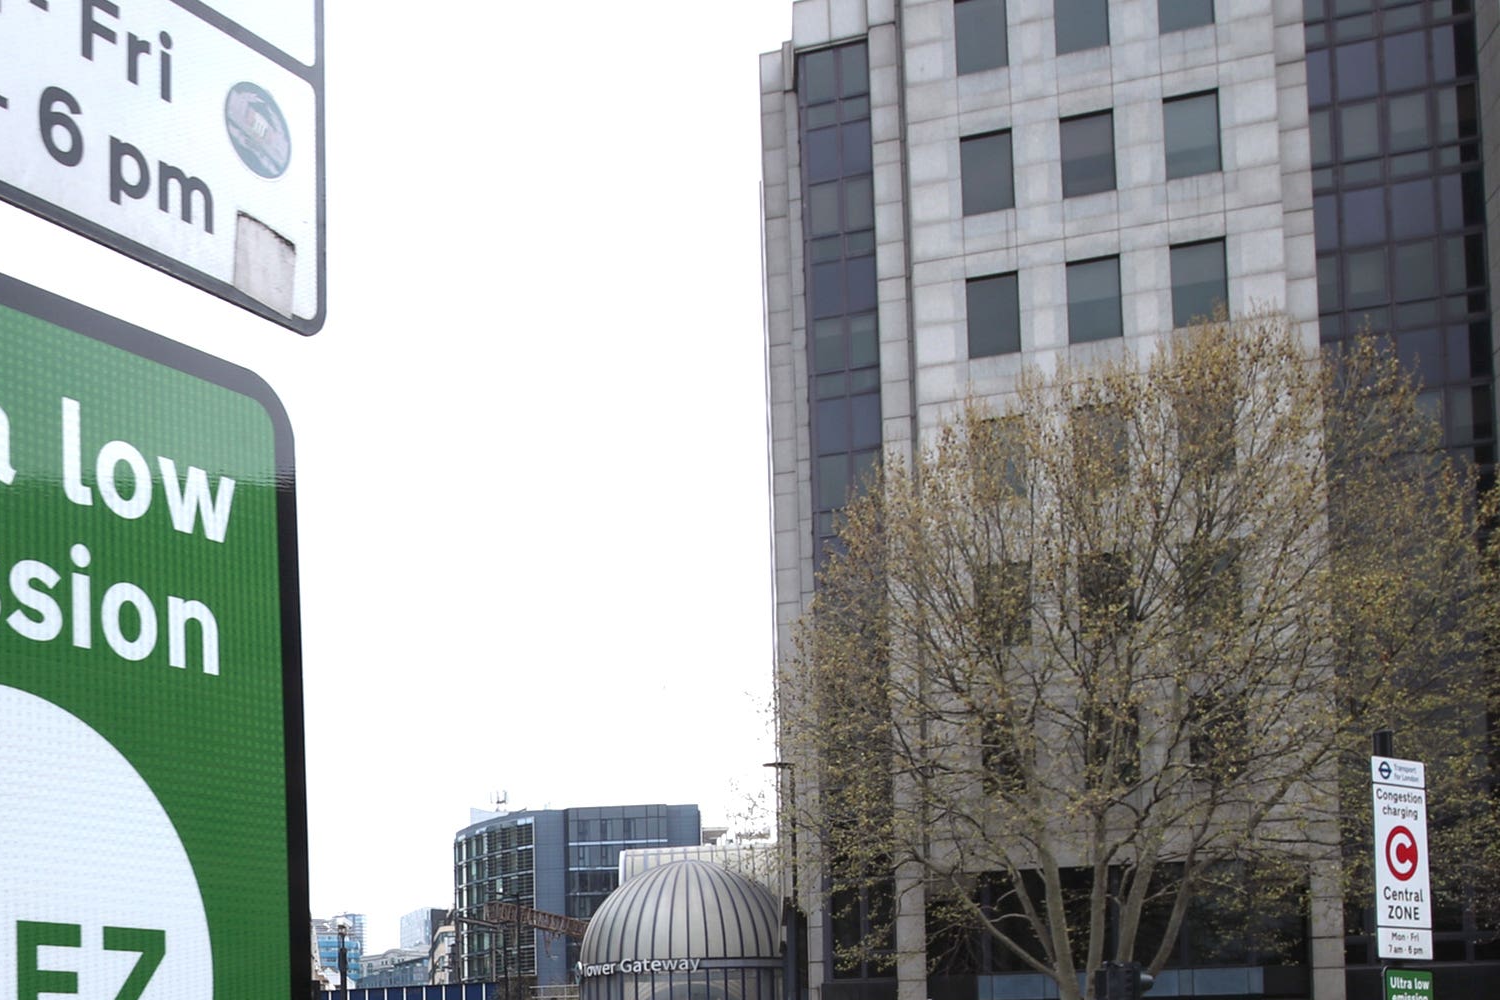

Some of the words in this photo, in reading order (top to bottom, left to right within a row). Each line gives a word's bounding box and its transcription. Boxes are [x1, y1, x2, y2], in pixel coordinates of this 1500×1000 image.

[82, 0, 174, 103] Fri
[37, 86, 85, 168] 6
[109, 134, 215, 235] pm
[61, 396, 237, 544] low
[1376, 787, 1423, 804] Congestion
[1382, 803, 1419, 821] charging
[1383, 886, 1424, 903] Central
[1388, 905, 1421, 921] ZONE
[582, 961, 617, 978] Tower
[620, 958, 701, 974] Gateway
[1389, 975, 1413, 990] Ultra
[1414, 977, 1431, 991] low
